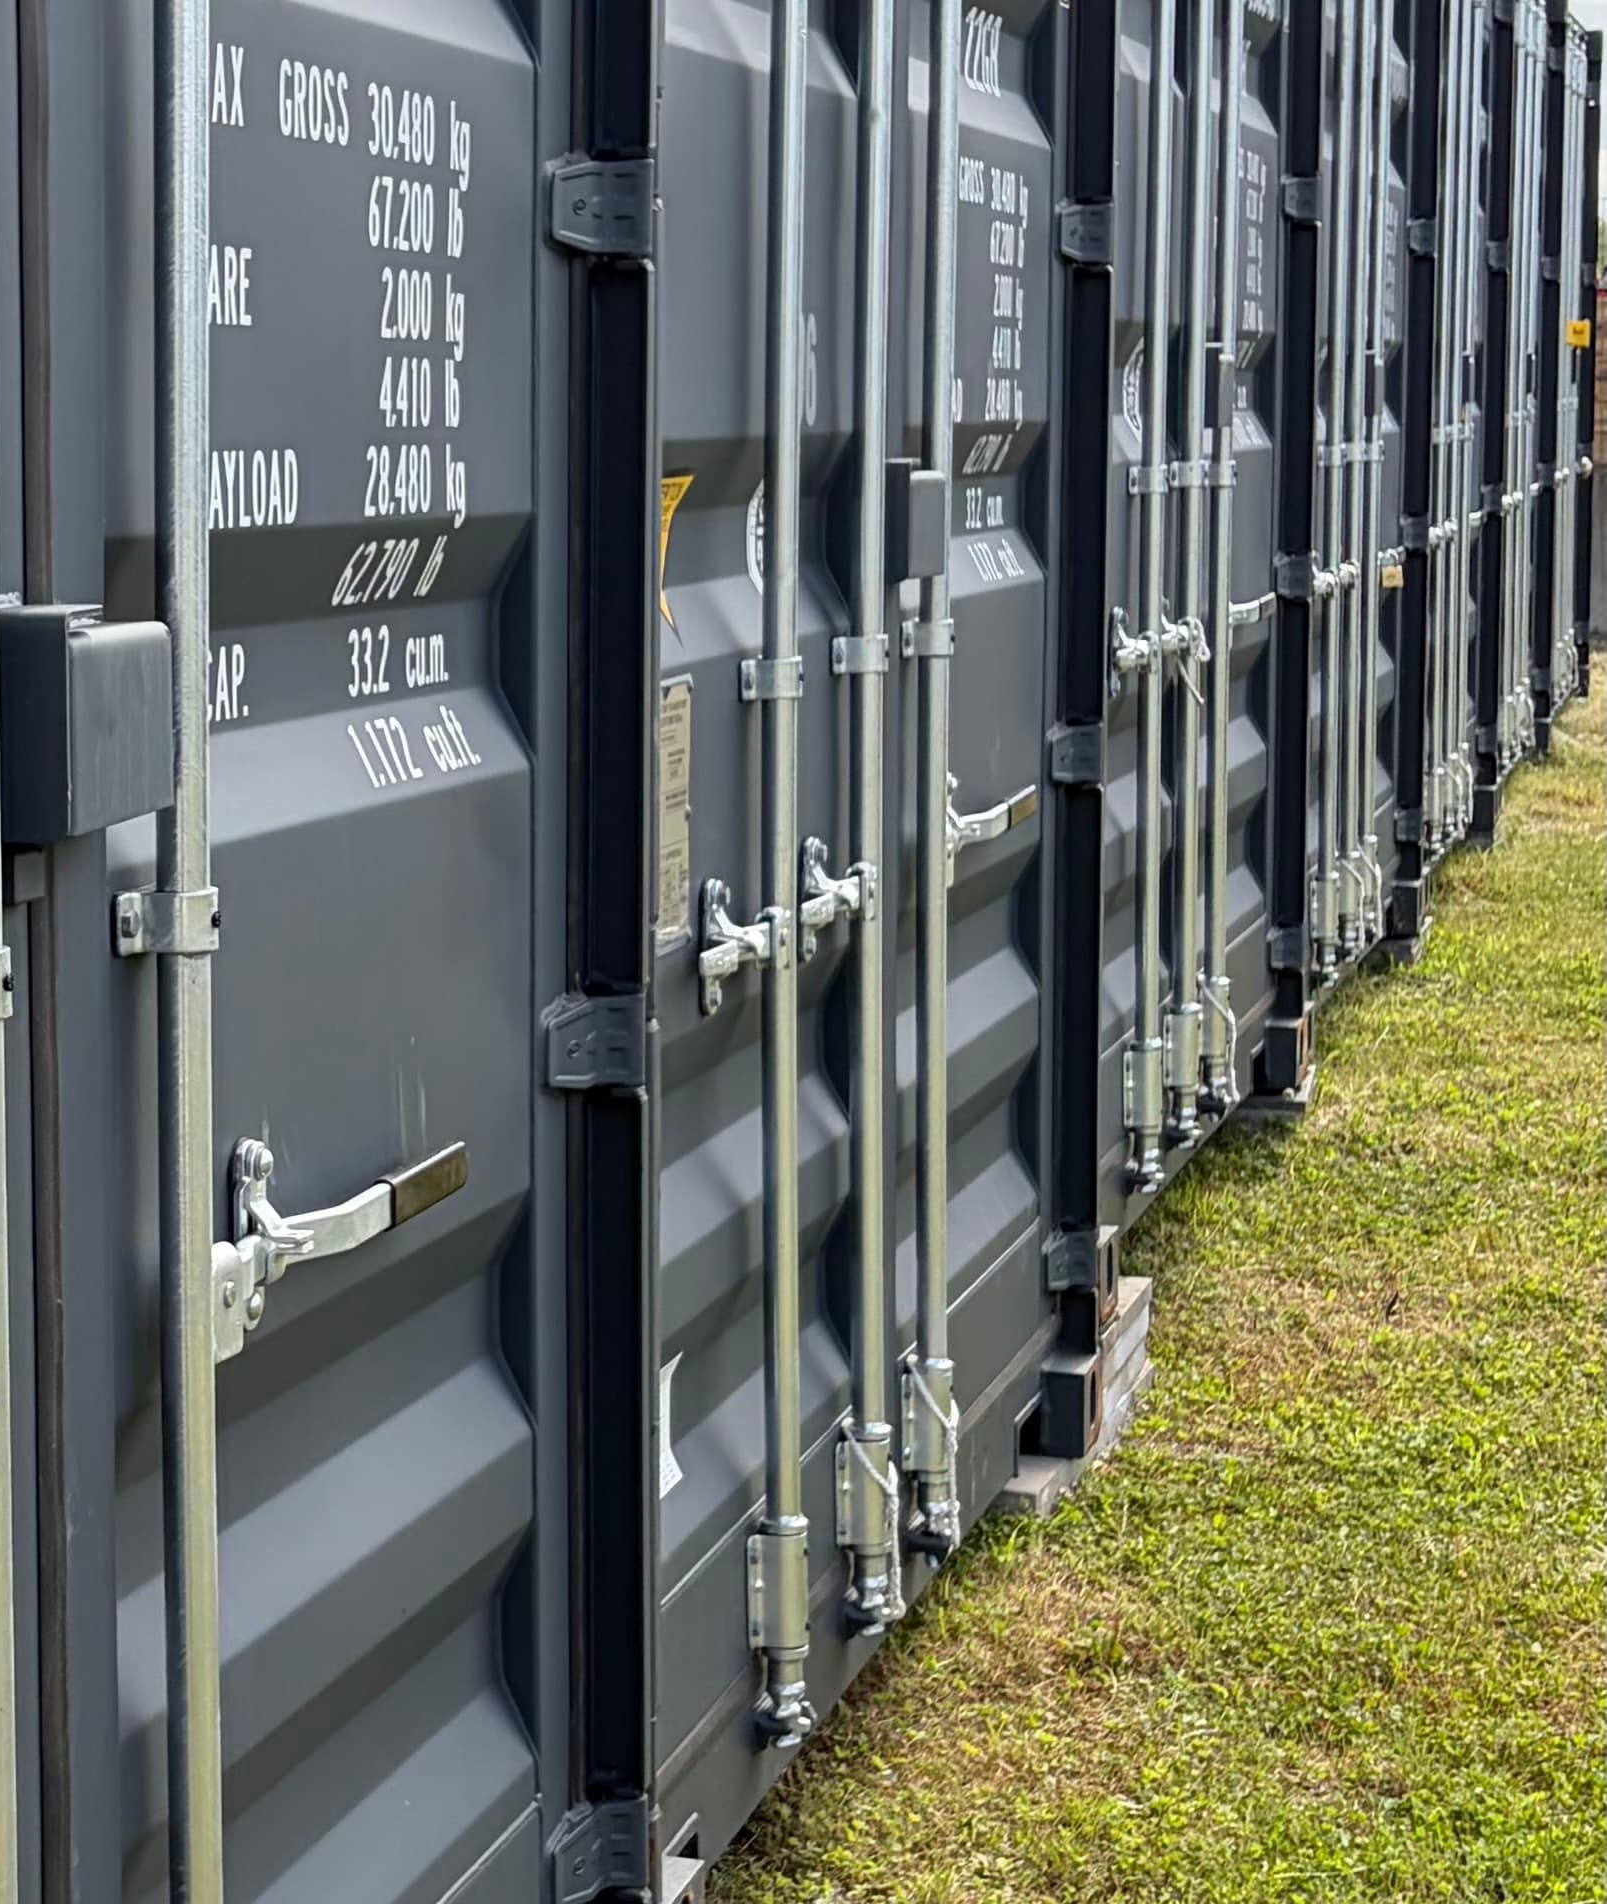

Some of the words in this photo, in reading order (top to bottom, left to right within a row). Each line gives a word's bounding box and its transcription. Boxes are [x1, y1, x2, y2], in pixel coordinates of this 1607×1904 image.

[212, 42, 244, 127] AX
[279, 58, 349, 146] GROSS
[450, 100, 470, 192] kg
[447, 187, 464, 258] lb
[207, 244, 252, 326] ARE
[445, 273, 465, 362] kg
[445, 358, 460, 428] lb
[209, 449, 298, 530] AYLOAD
[446, 443, 465, 529] kg
[413, 535, 447, 597] lb
[207, 643, 248, 722] AP.
[348, 624, 390, 697] 33.2
[405, 633, 448, 688] cu.m.
[423, 704, 482, 773] cu.ft.
